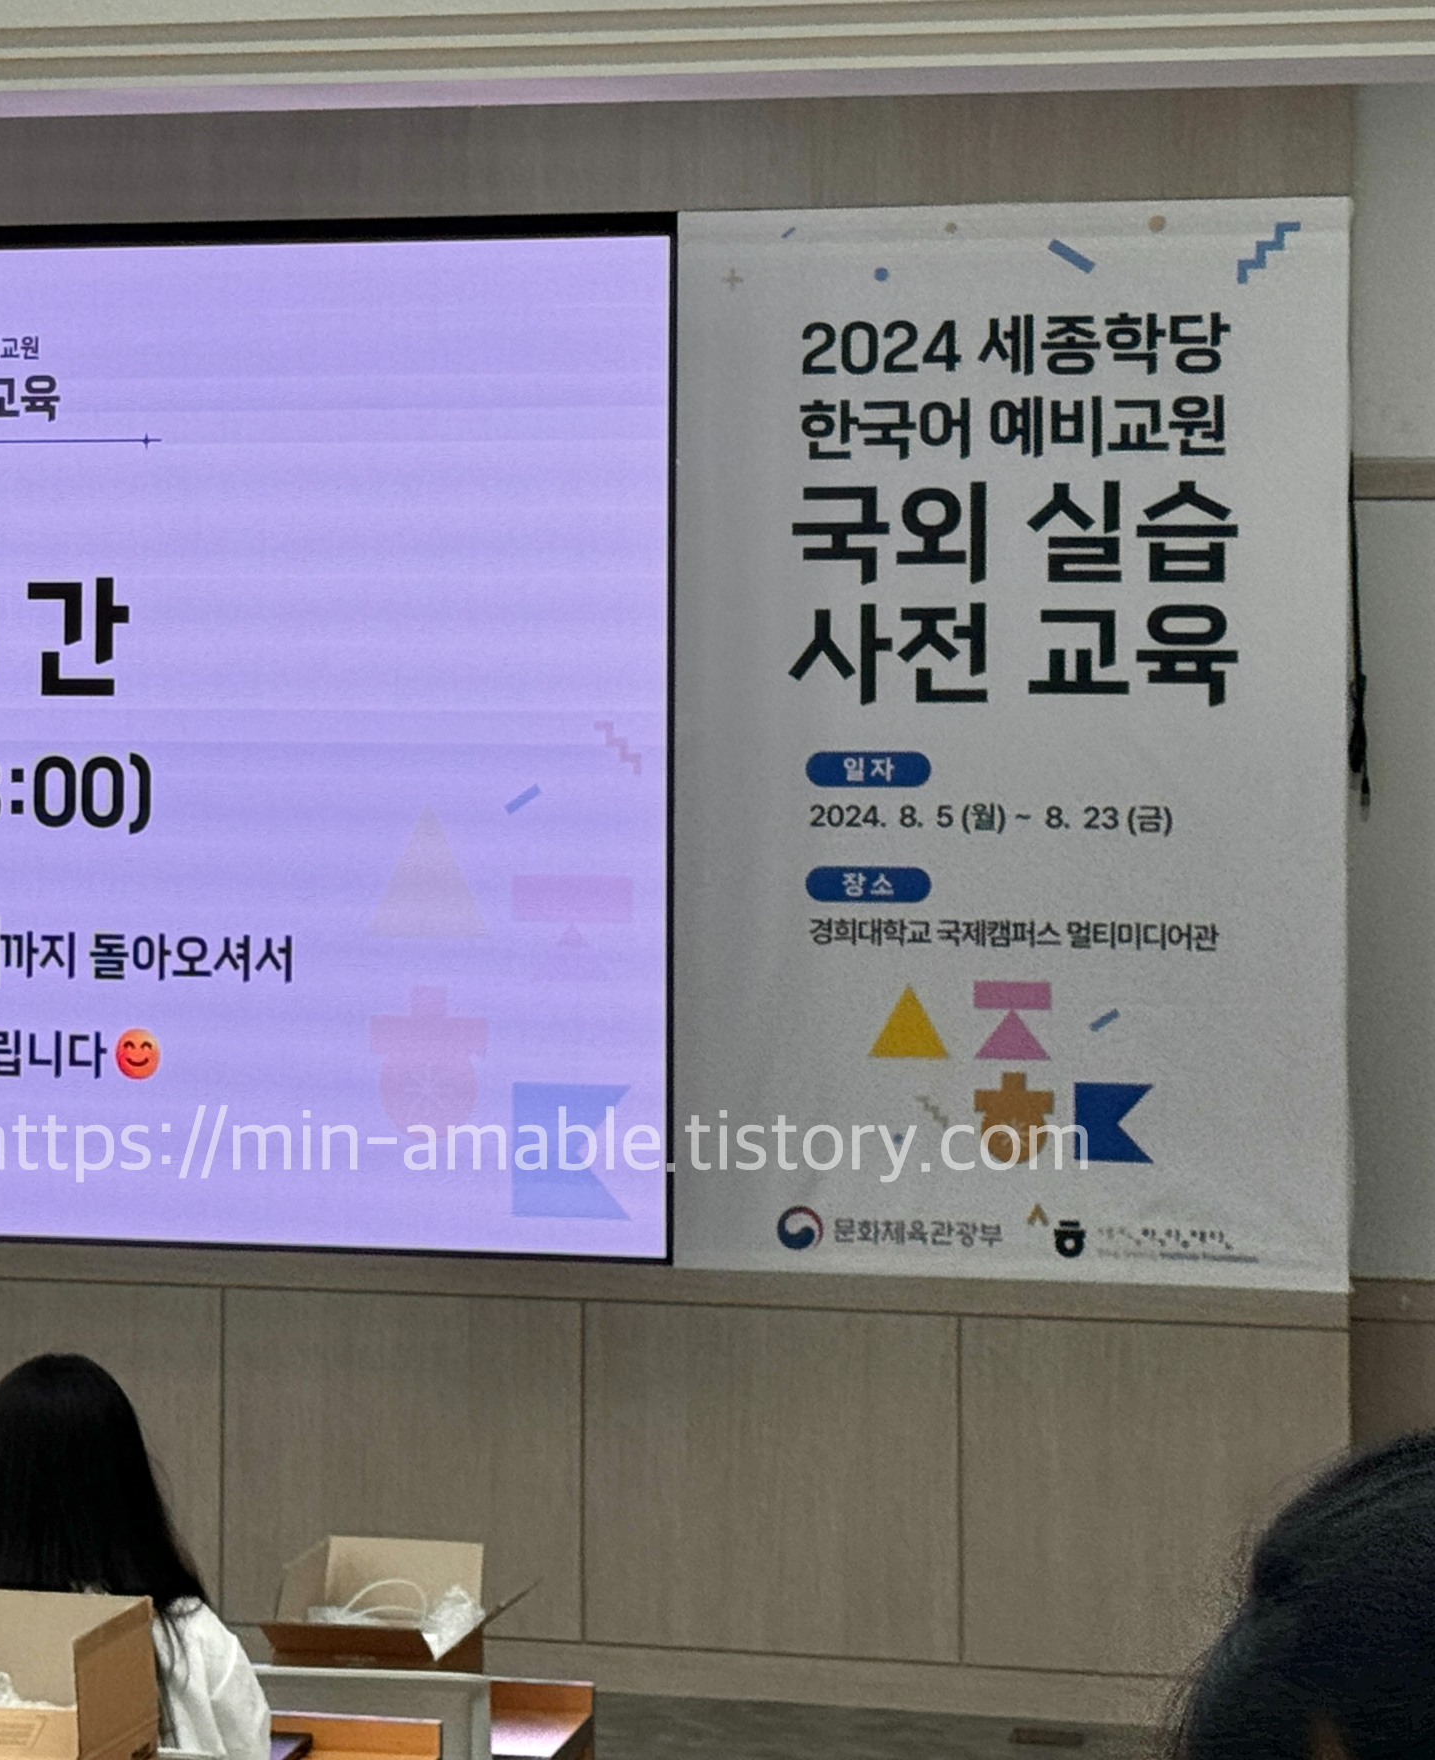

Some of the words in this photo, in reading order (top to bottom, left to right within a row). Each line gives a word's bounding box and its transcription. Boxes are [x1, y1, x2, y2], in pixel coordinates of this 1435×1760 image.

[801, 319, 962, 376] 2024
[977, 311, 1231, 376] 세종학당
[799, 397, 971, 461] 한국어
[989, 394, 1226, 458] 예비교원
[791, 481, 987, 586] 국외
[1026, 480, 1239, 583] 실습
[788, 602, 988, 706] 사전
[1028, 604, 1239, 707] 교육
[89, 933, 292, 983] 돌아오셔서
[809, 917, 932, 947] 경희대학교
[936, 919, 1061, 948] 국제캠퍼스
[1066, 920, 1220, 952] 멀티미디어관
[834, 1217, 1003, 1248] 문화체육관광부
